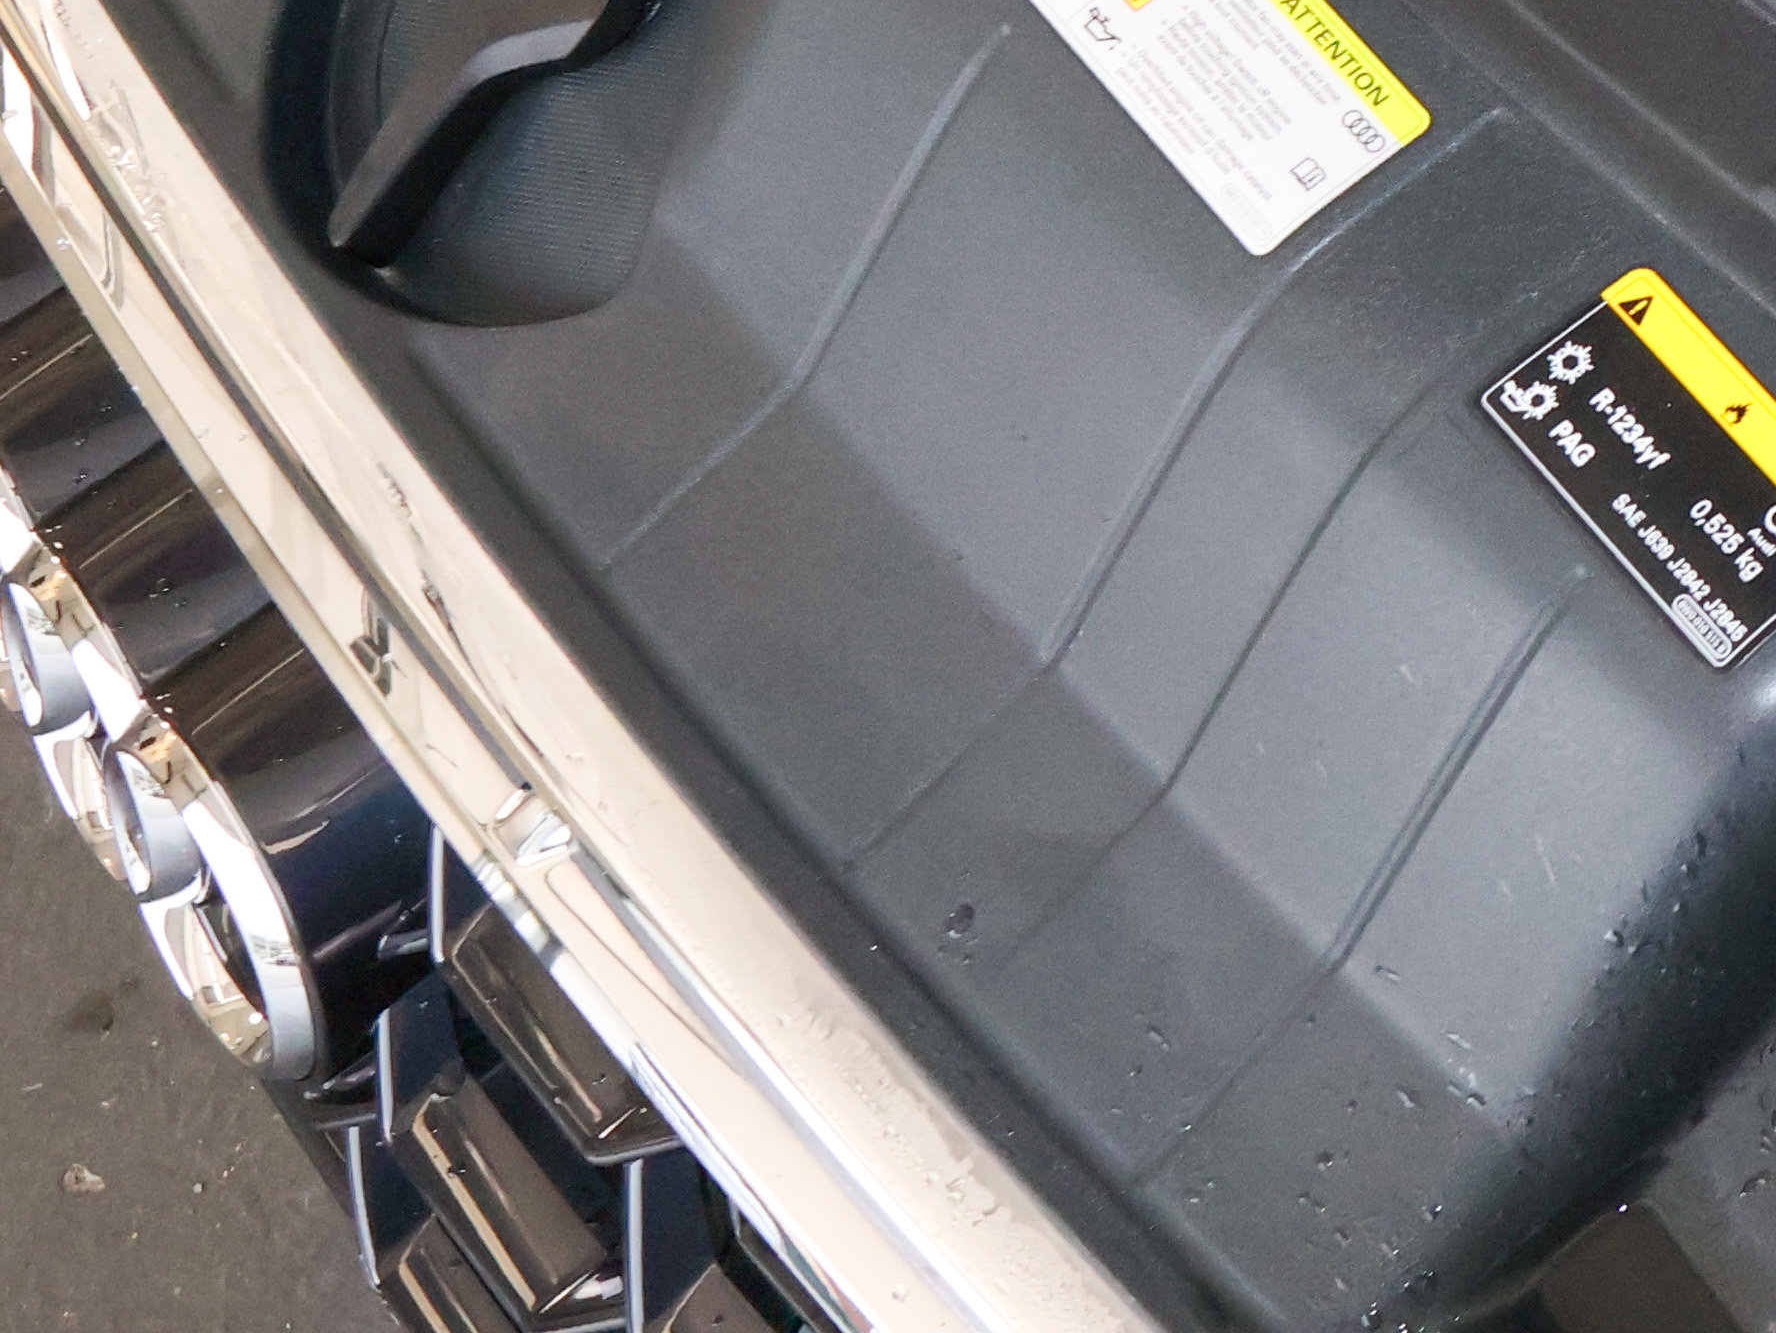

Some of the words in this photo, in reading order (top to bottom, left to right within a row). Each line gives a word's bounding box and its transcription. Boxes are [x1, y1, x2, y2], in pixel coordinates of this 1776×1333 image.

[1548, 419, 1595, 467] PAG
[1588, 387, 1671, 469] R-1234yf
[1689, 498, 1745, 554] 0,525
[1733, 546, 1765, 582] kg
[1611, 493, 1647, 528] SAE
[1637, 524, 1675, 560] J639
[1666, 557, 1711, 601] J2842
[1702, 597, 1748, 642] J2845
